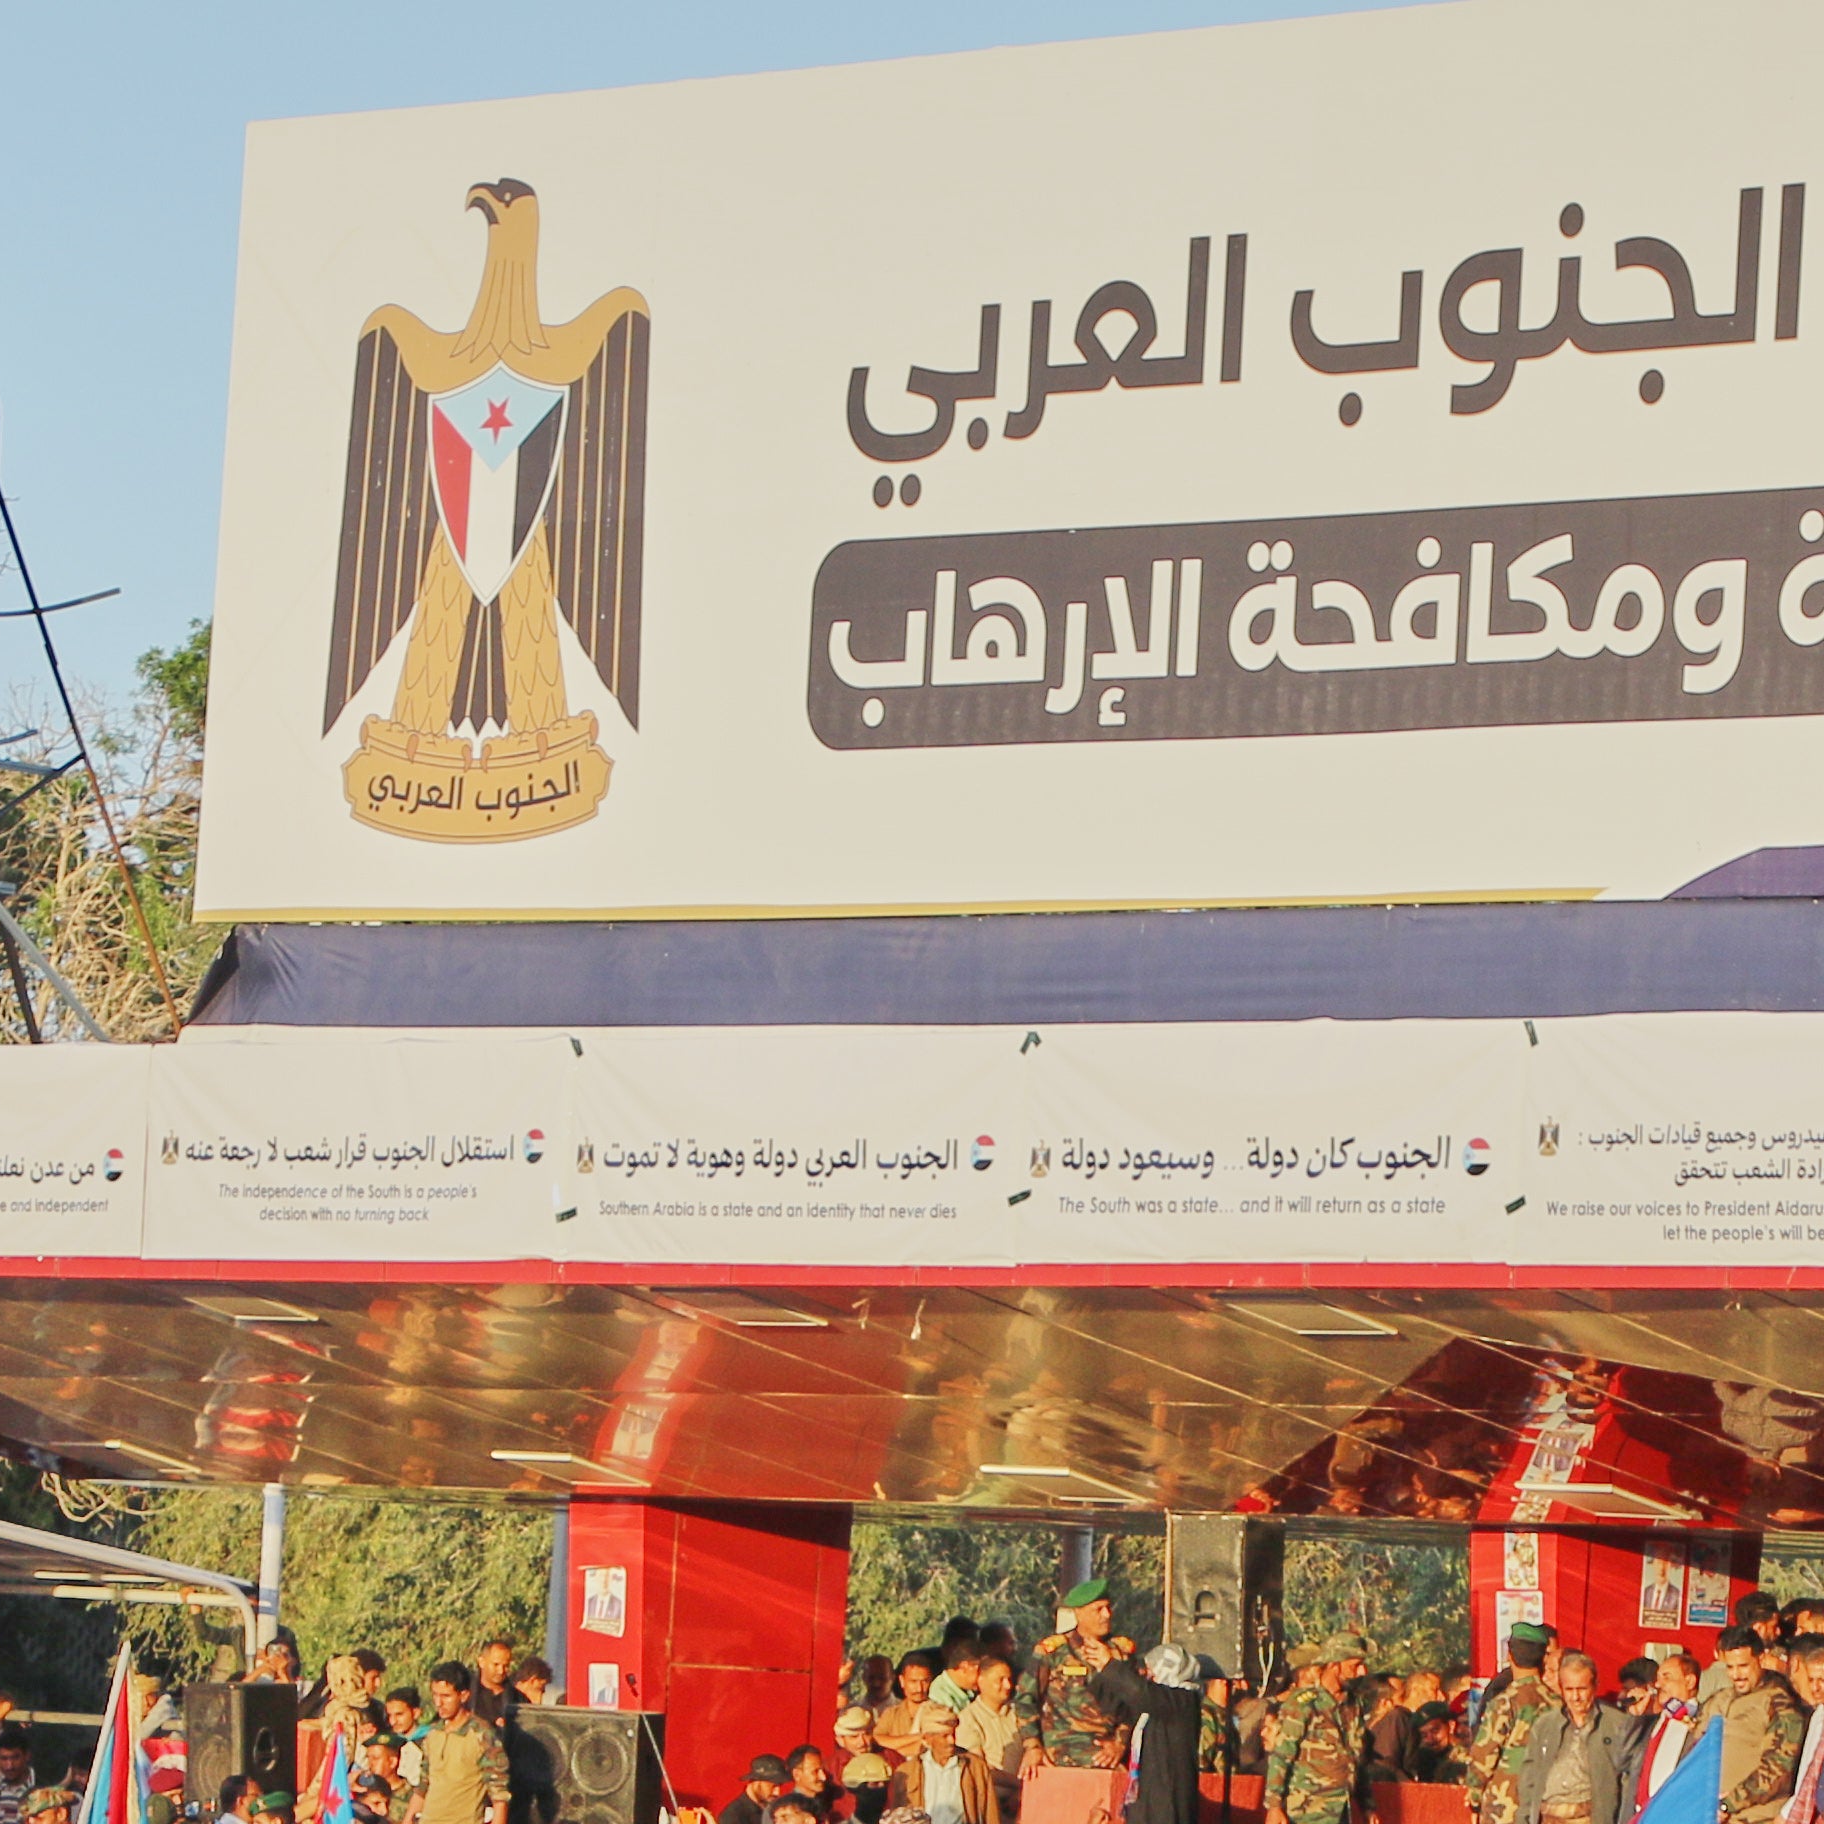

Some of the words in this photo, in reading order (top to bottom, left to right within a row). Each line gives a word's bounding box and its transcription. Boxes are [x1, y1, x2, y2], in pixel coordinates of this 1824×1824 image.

[1289, 182, 1806, 427] الجنوب
[846, 233, 1248, 508] العربي
[1229, 536, 1747, 695] ومكافحة
[830, 559, 1201, 725] الإرهاب
[368, 774, 464, 814] العربي
[475, 760, 580, 821] الجنوب
[1648, 1120, 1701, 1148] قيادات
[1706, 1128, 1756, 1153] وجميع
[185, 1143, 214, 1161] عنه
[220, 1137, 260, 1168] رجعة
[267, 1137, 277, 1162] لا
[284, 1137, 331, 1169] شعب
[336, 1133, 367, 1168] قرار
[441, 1133, 513, 1167] استقلال
[603, 1142, 661, 1177] تموت
[667, 1140, 679, 1168] لا
[687, 1138, 744, 1177] وهوية
[806, 1139, 866, 1187] العربي
[1118, 1147, 1214, 1180] وسيعود
[1307, 1136, 1355, 1177] كان
[30, 1156, 64, 1184] عدن
[69, 1160, 94, 1184] من
[1674, 1159, 1728, 1187] تتحقق
[1732, 1158, 1790, 1186] الشعب
[243, 1183, 328, 1201] independence
[428, 1183, 476, 1201] people's
[1135, 1200, 1163, 1214] was
[1182, 1197, 1233, 1214] state...
[1288, 1195, 1311, 1213] will
[1316, 1196, 1361, 1214] return
[260, 1206, 307, 1222] decision
[311, 1207, 332, 1221] with
[354, 1207, 394, 1225] turning
[399, 1207, 429, 1222] back
[599, 1200, 649, 1216] Southern
[653, 1201, 694, 1217] Arabia
[722, 1202, 753, 1218] state
[757, 1202, 782, 1218] and
[807, 1202, 854, 1221] identity
[859, 1203, 885, 1219] that
[890, 1206, 925, 1219] never
[930, 1203, 956, 1219] dies
[1572, 1200, 1605, 1217] raise
[1637, 1200, 1680, 1217] voices
[1705, 1200, 1769, 1217] President
[1663, 1224, 1678, 1241] let
[1712, 1225, 1774, 1244] people's
[1779, 1224, 1801, 1240] will
